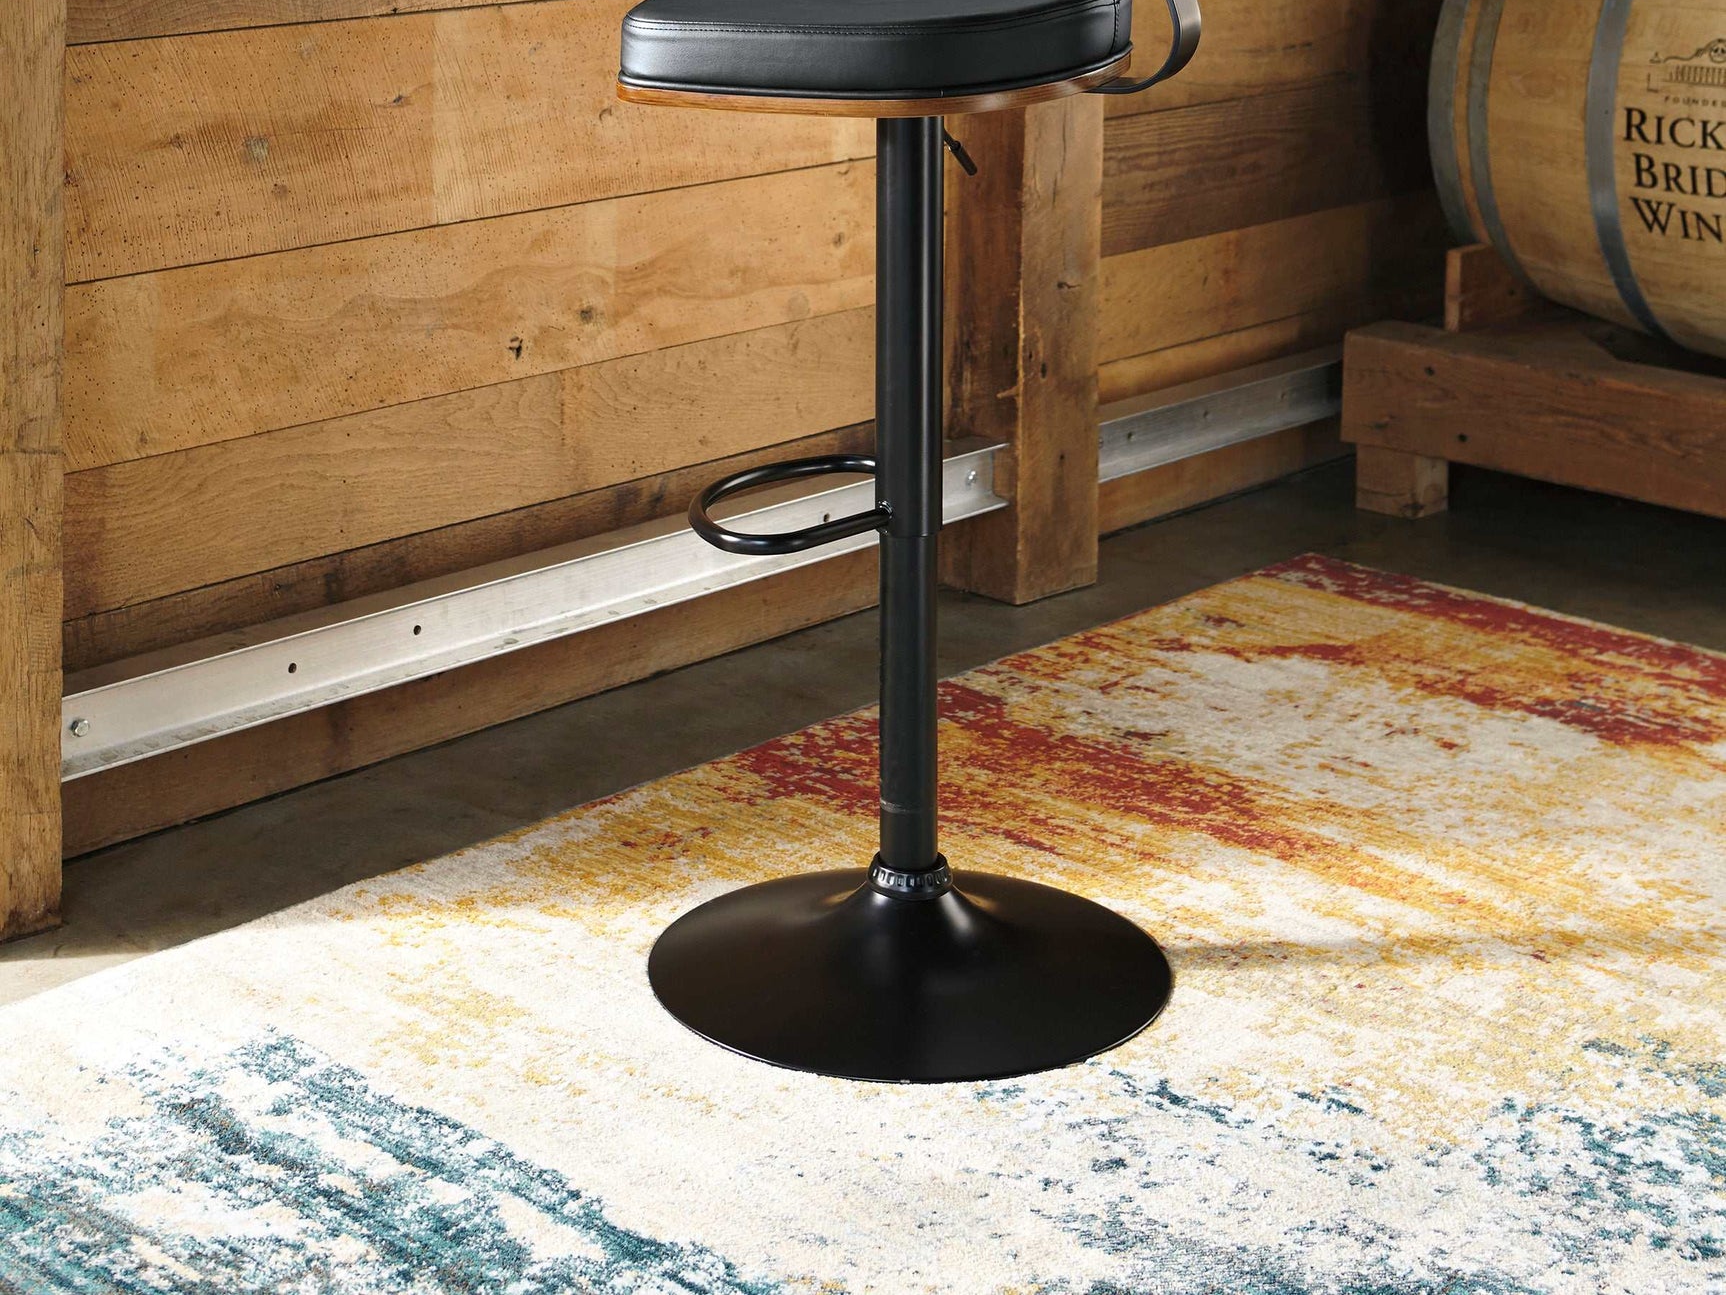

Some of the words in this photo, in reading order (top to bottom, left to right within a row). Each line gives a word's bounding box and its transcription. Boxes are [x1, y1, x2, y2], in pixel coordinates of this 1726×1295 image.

[1623, 107, 1726, 150] RICK
[1633, 153, 1726, 197] BRID
[1630, 197, 1723, 243] WIN
